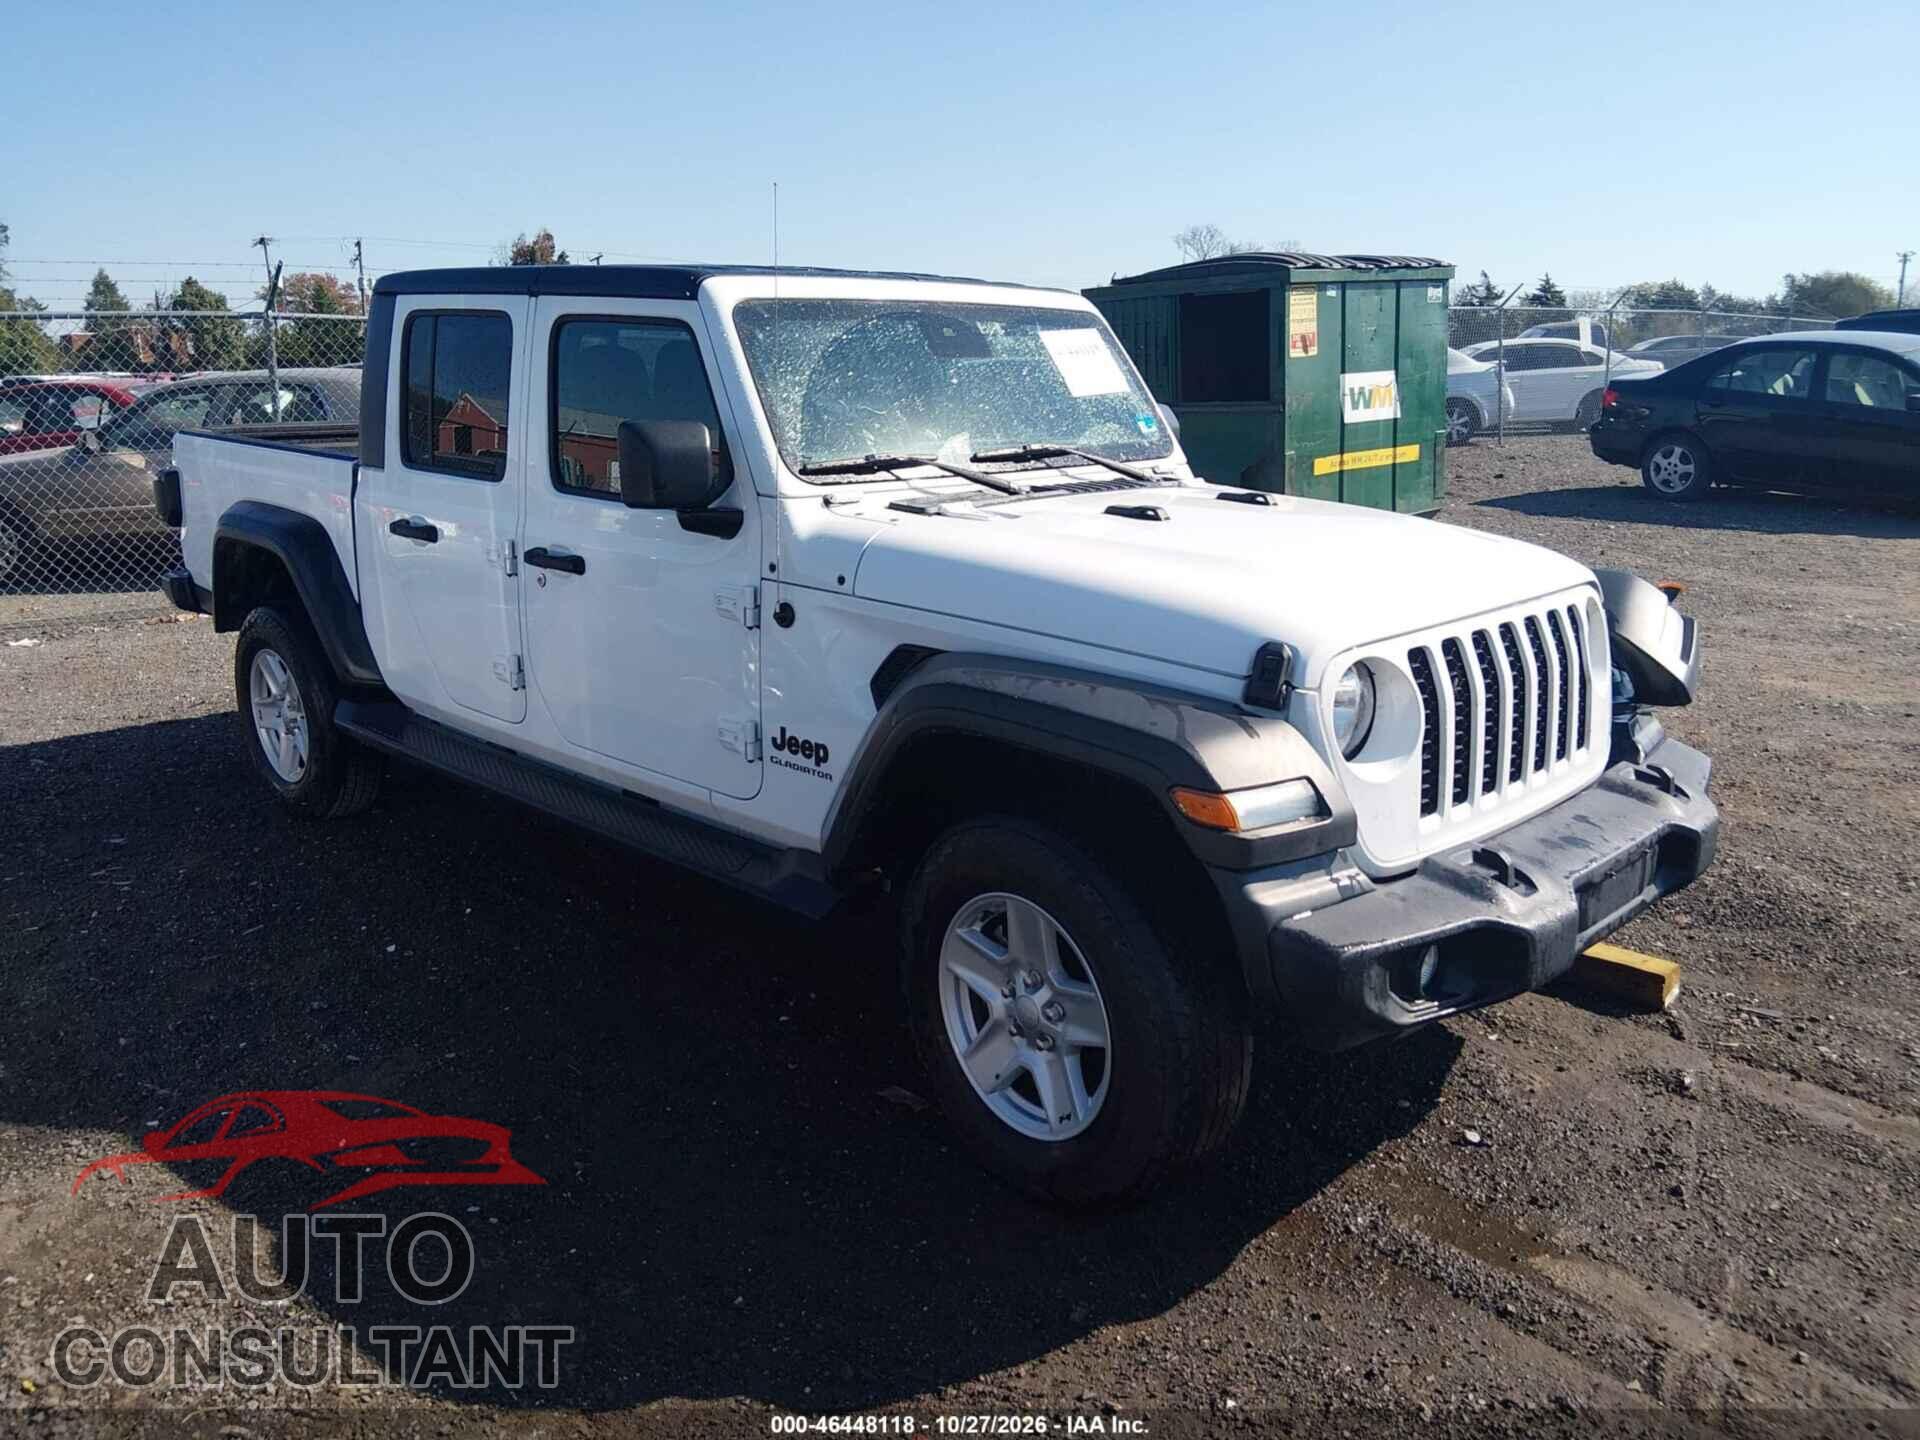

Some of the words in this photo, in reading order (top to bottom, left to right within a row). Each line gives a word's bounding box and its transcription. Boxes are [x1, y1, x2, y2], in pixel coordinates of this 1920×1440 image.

[1349, 385, 1393, 411] WM
[771, 726, 829, 767] Jeep
[769, 755, 832, 781] GLADIATOR
